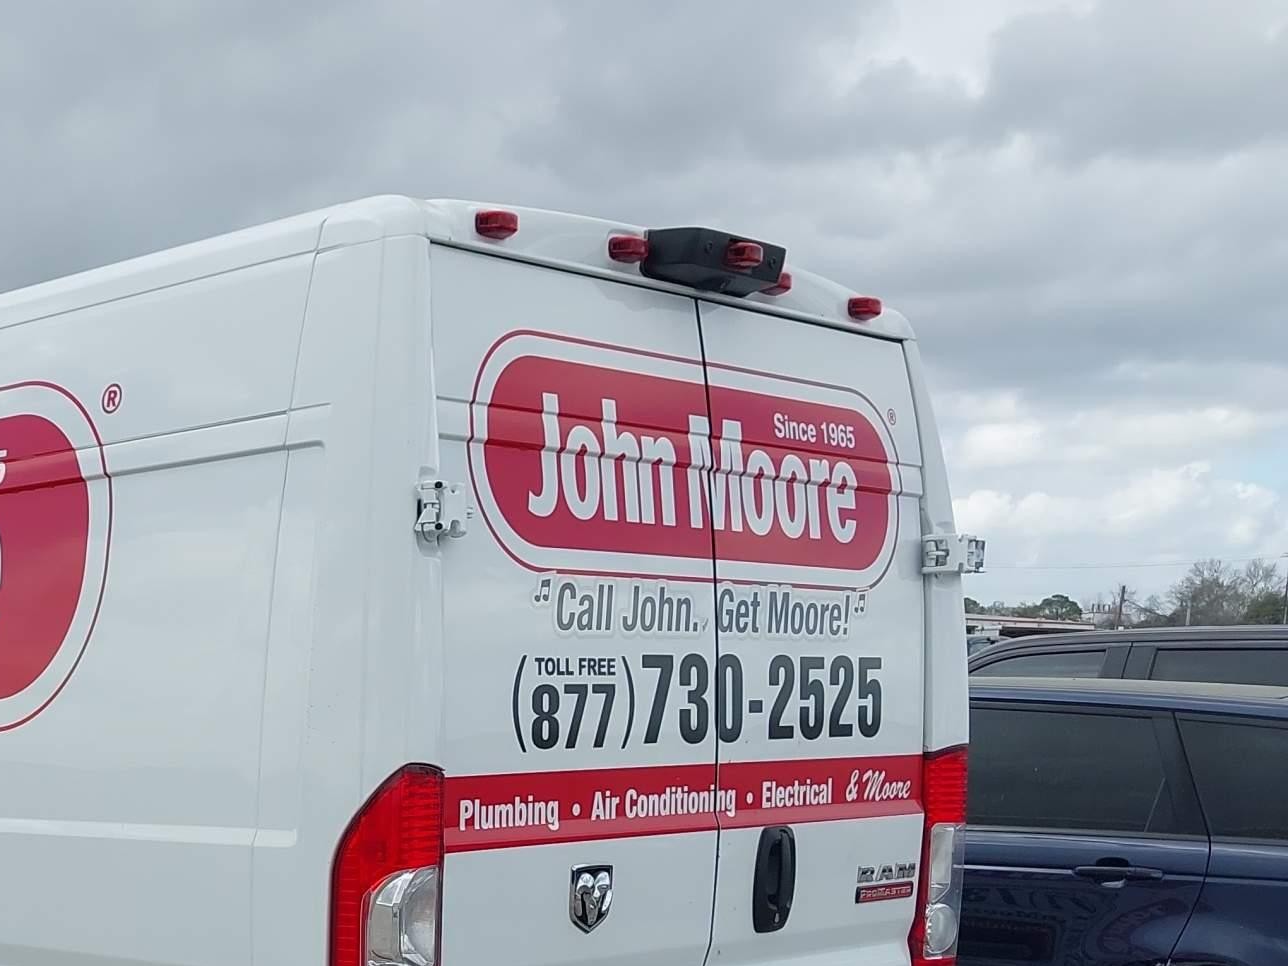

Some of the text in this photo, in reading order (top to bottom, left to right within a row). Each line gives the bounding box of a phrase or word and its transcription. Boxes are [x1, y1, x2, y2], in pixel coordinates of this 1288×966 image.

[773, 412, 856, 449] Since 1965
[527, 392, 858, 544] John Moore
[555, 582, 614, 631] Call
[718, 588, 761, 633] Get
[768, 591, 851, 635] Moore!
[534, 657, 617, 677] TOLL FREE
[641, 652, 883, 745] 730-2525
[459, 769, 912, 832] Plumbing Air Conditioning Electrical & Moore
[857, 862, 916, 884] RAM
